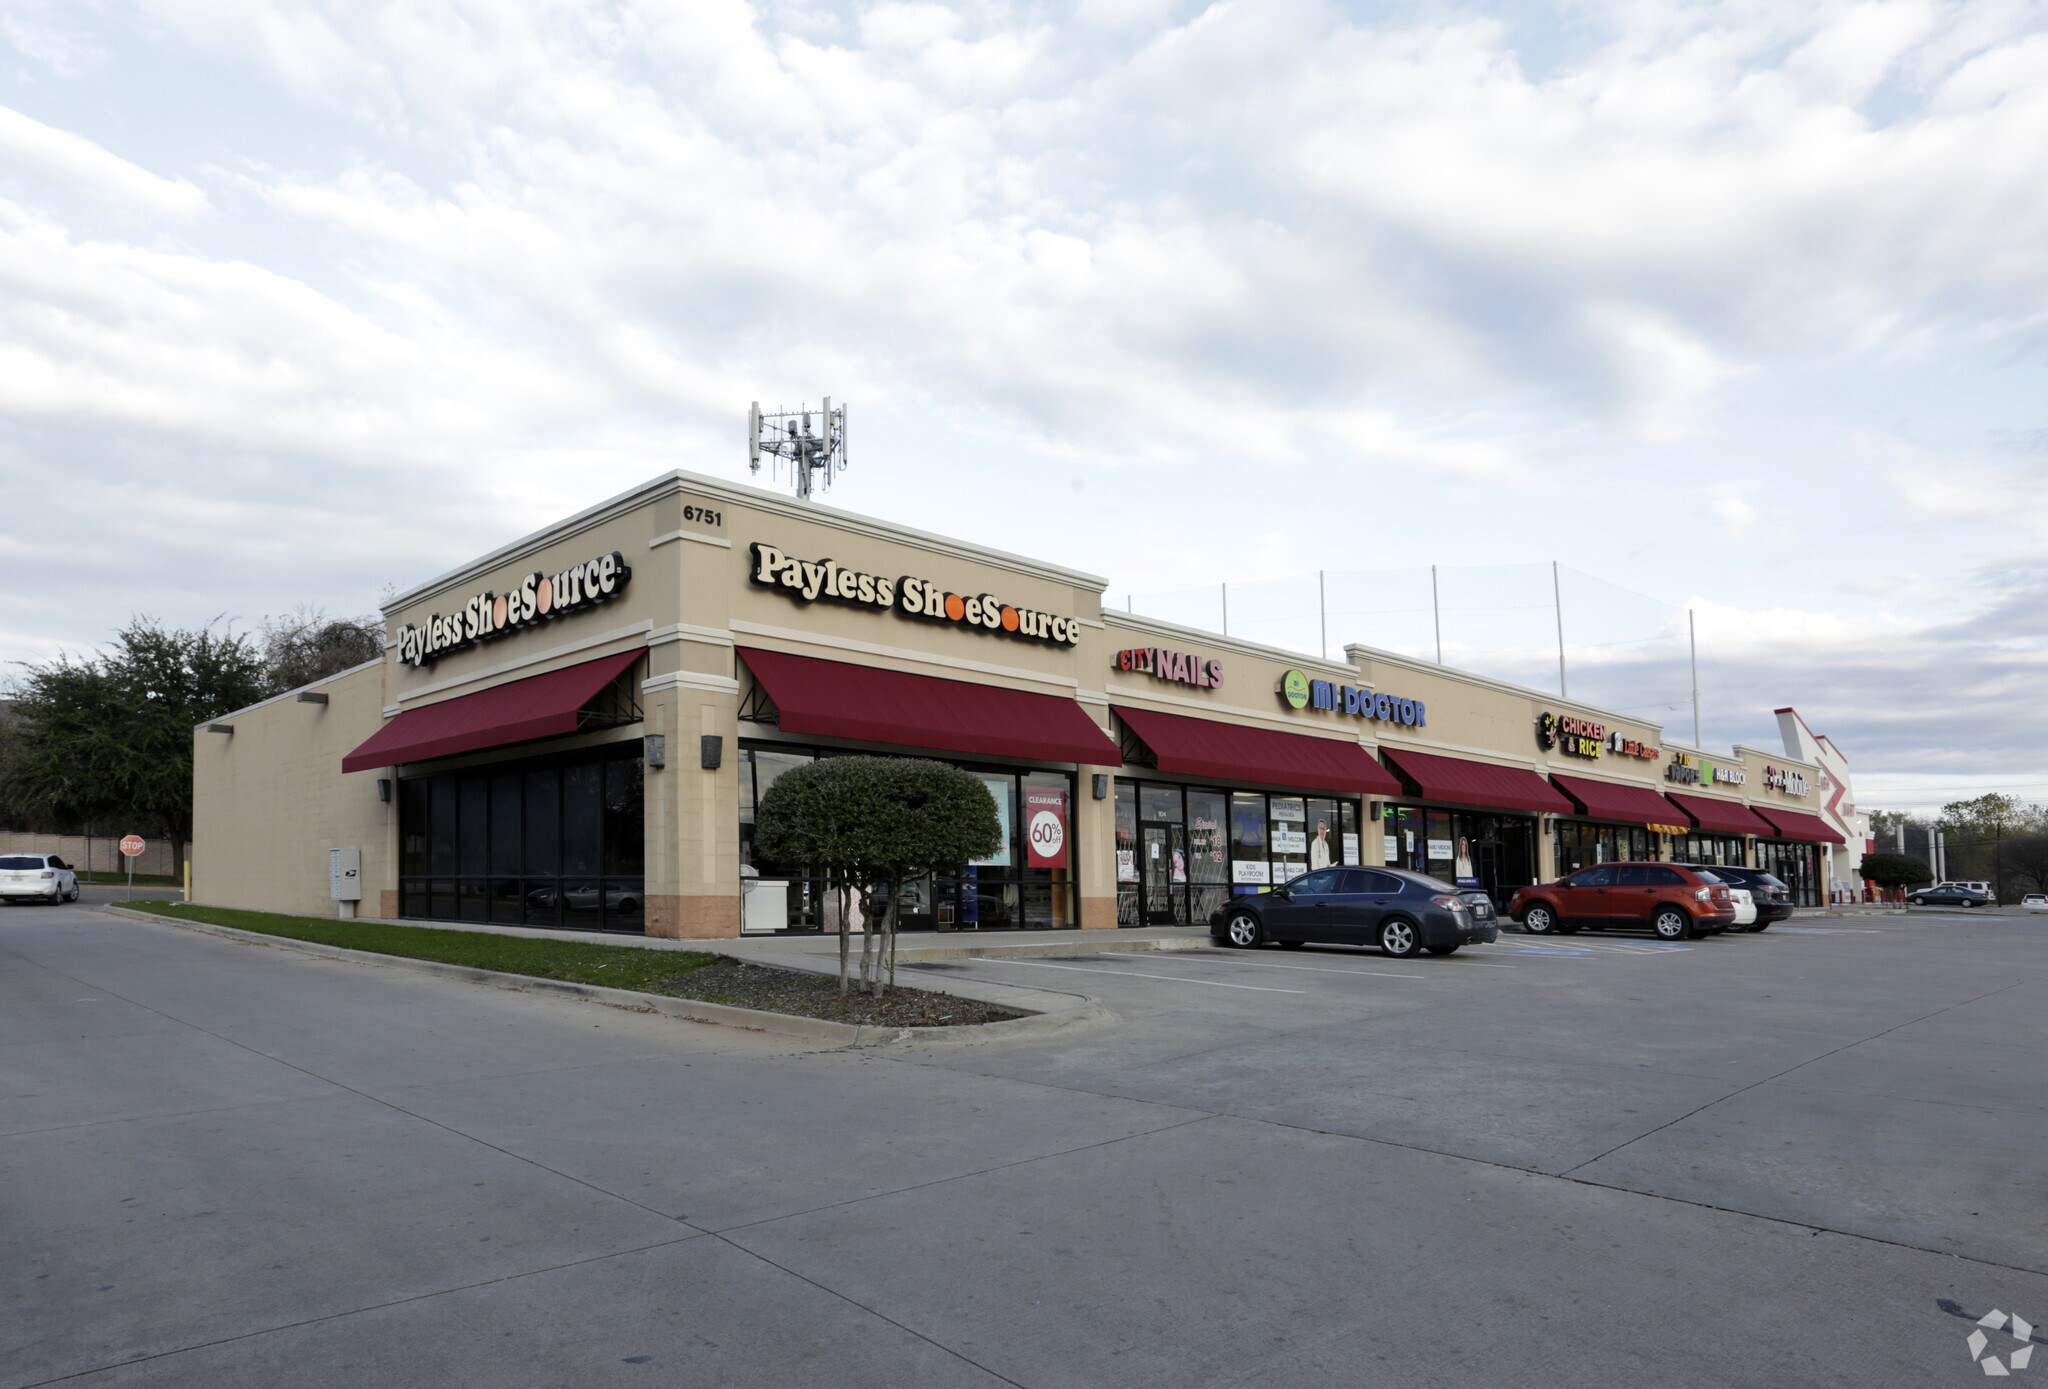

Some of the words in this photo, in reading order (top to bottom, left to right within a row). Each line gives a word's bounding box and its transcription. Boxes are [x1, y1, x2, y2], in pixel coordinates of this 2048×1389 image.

[683, 505, 722, 527] 6751
[757, 544, 894, 607] Payless
[902, 577, 1081, 644] ShoeSource
[396, 612, 463, 667] Payless
[465, 553, 616, 639] ShoeSource
[1119, 648, 1154, 671] CITY
[1156, 648, 1223, 689] NAILS
[1313, 679, 1338, 712] MI
[1344, 685, 1426, 727] DOCTOR
[1562, 716, 1606, 740] CHICKEN
[1567, 737, 1575, 752] &
[1578, 738, 1601, 757] RICE
[1716, 767, 1729, 782] H&R
[1729, 769, 1747, 785] BLOCK
[1028, 796, 1062, 806] CLEARANCE
[1272, 802, 1302, 812] PEDIATRICS
[121, 841, 144, 850] STOP
[1052, 835, 1062, 844] off
